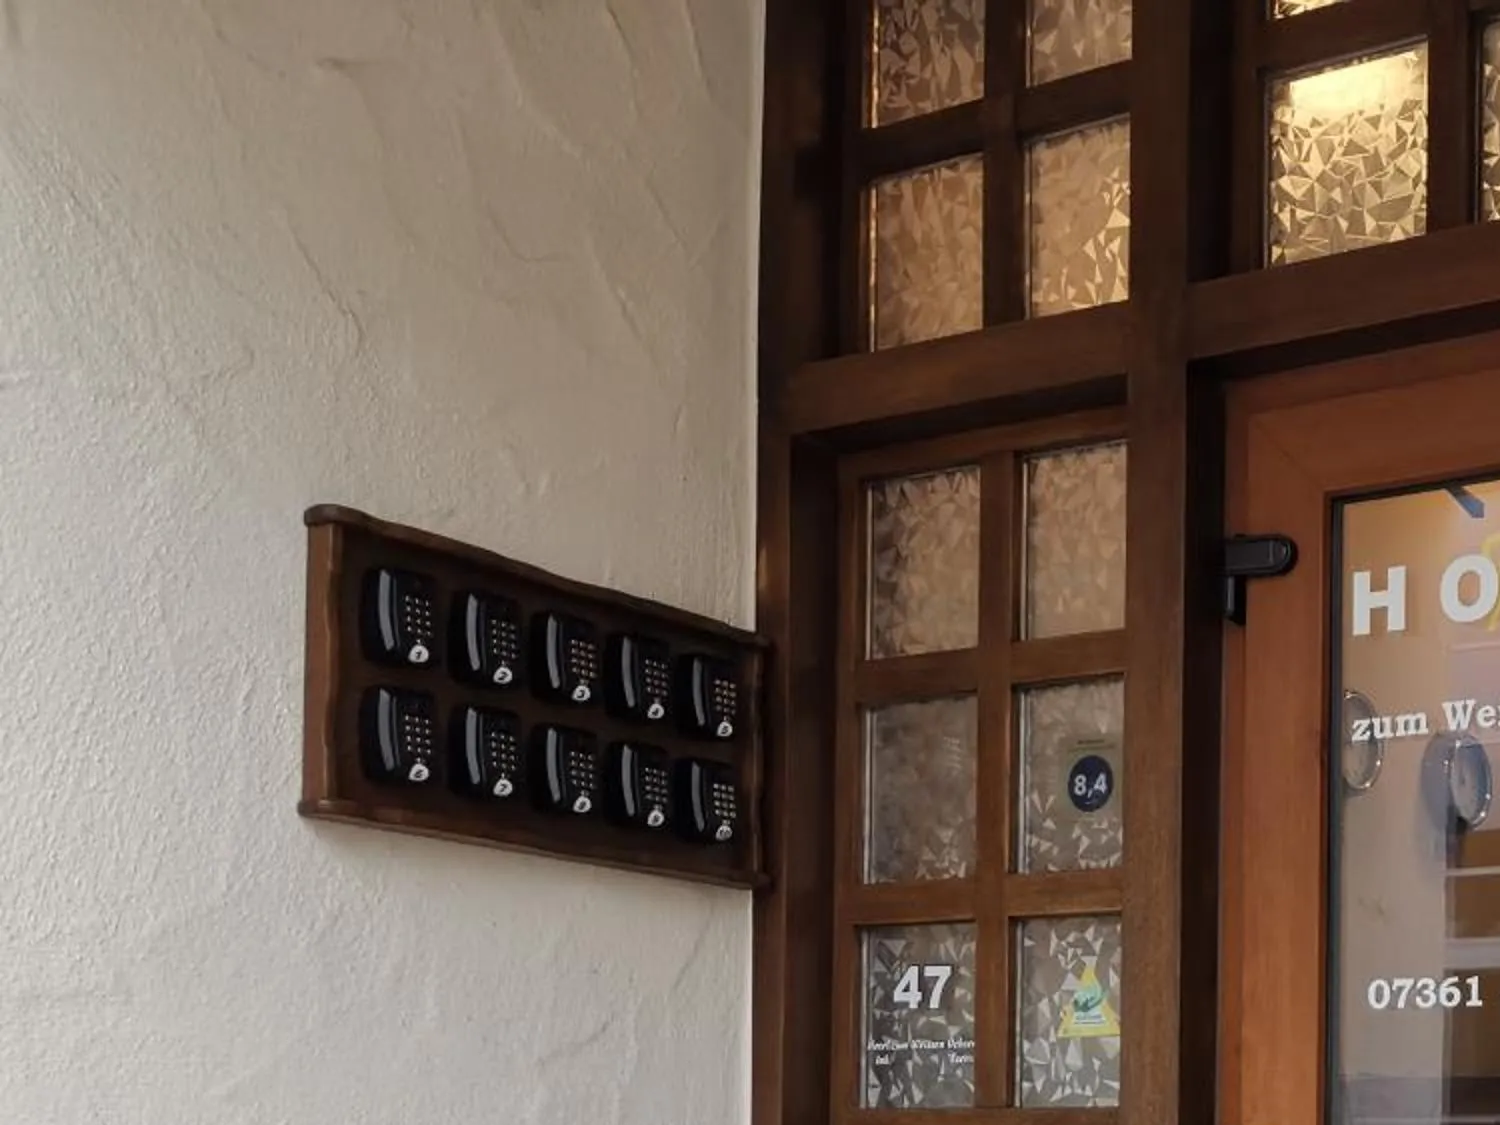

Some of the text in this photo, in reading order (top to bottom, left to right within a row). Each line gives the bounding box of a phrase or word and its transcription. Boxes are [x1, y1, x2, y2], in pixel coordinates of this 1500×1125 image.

[1351, 708, 1430, 742] zum
[1074, 773, 1108, 799] 8,4
[893, 965, 953, 1010] 47
[1367, 976, 1483, 1009] 07361
